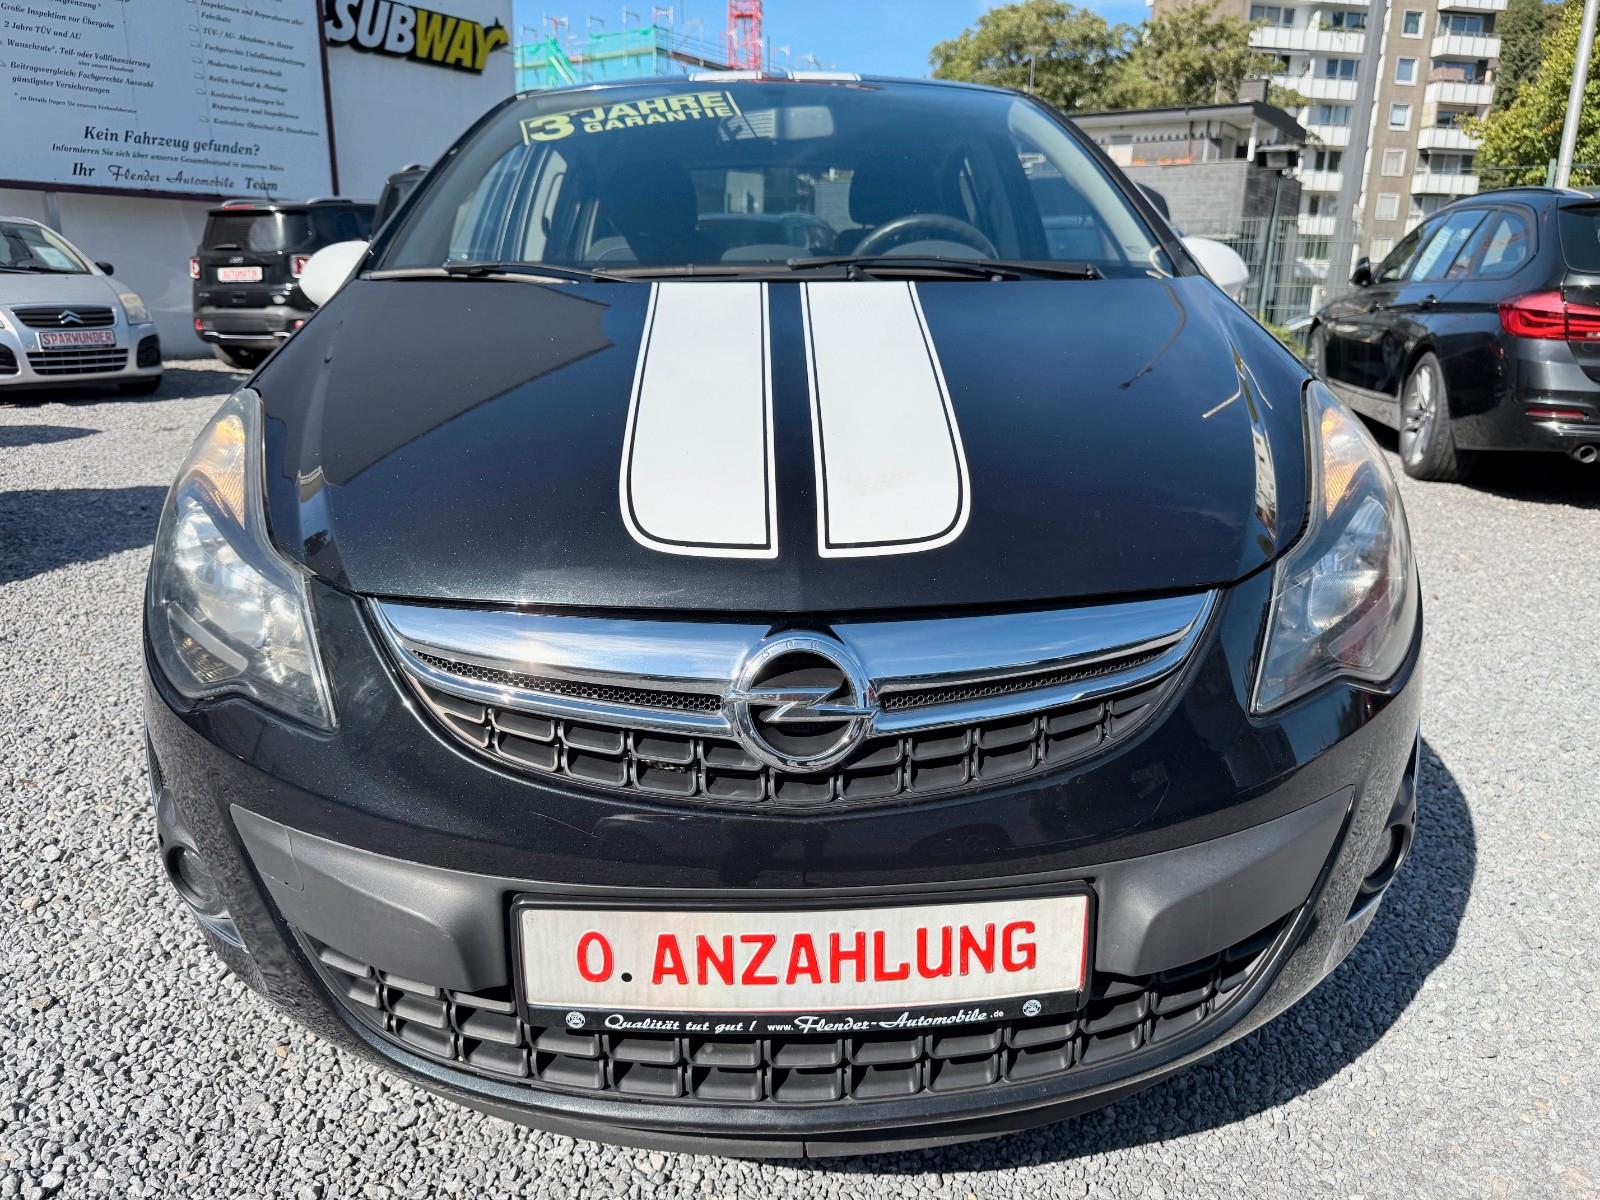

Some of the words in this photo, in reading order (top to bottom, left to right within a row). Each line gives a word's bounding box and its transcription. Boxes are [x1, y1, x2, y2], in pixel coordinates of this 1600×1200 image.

[1, 2, 25, 13] Große
[27, 7, 66, 21] Inspektion
[69, 15, 80, 23] vor
[82, 15, 115, 29] Übergabe
[4, 20, 10, 28] 2
[11, 22, 33, 32] Jahre
[35, 25, 52, 35] TÜV
[53, 29, 68, 38] und
[325, 0, 509, 72] SUBWAY
[60, 47, 75, 56] Teil-
[77, 50, 93, 59] oder
[95, 52, 151, 69] Vollfinanzierung
[10, 61, 76, 77] Beitragsvergleich:
[78, 71, 123, 84] Fachgerechte
[12, 76, 54, 88] günstigster
[56, 81, 110, 95] Versicherungen
[529, 114, 575, 141] 3
[581, 92, 729, 123] JAHRE
[584, 108, 733, 133] GARANTIE
[52, 143, 100, 156] Informieren
[101, 147, 113, 156] Sie
[115, 149, 131, 159] sich
[83, 126, 119, 142] Kein
[123, 130, 190, 152] Fahrzeug
[193, 139, 260, 156] gefunden?
[72, 163, 96, 177] Ihr
[107, 164, 161, 182] Flender
[166, 171, 235, 189] Automobile
[245, 177, 278, 191] Team
[43, 331, 112, 346] SPARWUNDER
[652, 920, 1037, 987] ANZAHLUNG
[604, 1013, 680, 1030] Qualität
[686, 1021, 710, 1031] tut
[715, 1021, 744, 1034] gut
